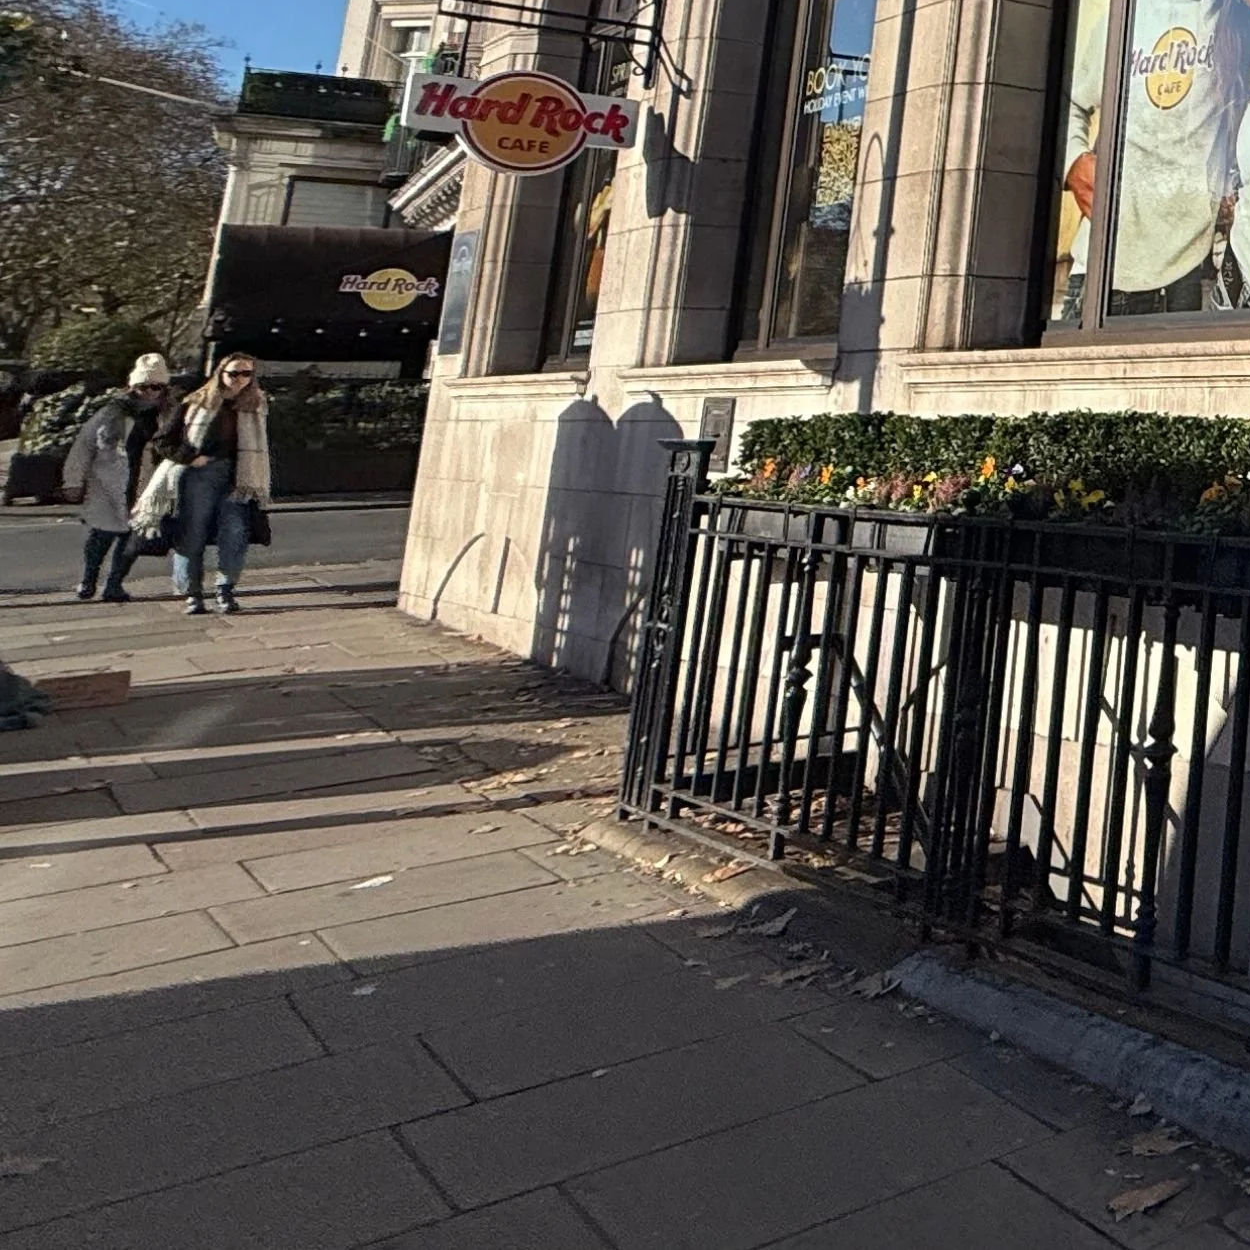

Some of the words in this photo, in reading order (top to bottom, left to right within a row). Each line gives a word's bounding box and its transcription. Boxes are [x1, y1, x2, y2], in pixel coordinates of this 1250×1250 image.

[1173, 34, 1215, 75] Rock
[1157, 80, 1182, 96] CAFE
[414, 81, 531, 125] Hard
[529, 95, 629, 143] Rock
[497, 136, 550, 154] CAFE
[341, 277, 391, 291] Hard
[391, 277, 438, 296] Rock
